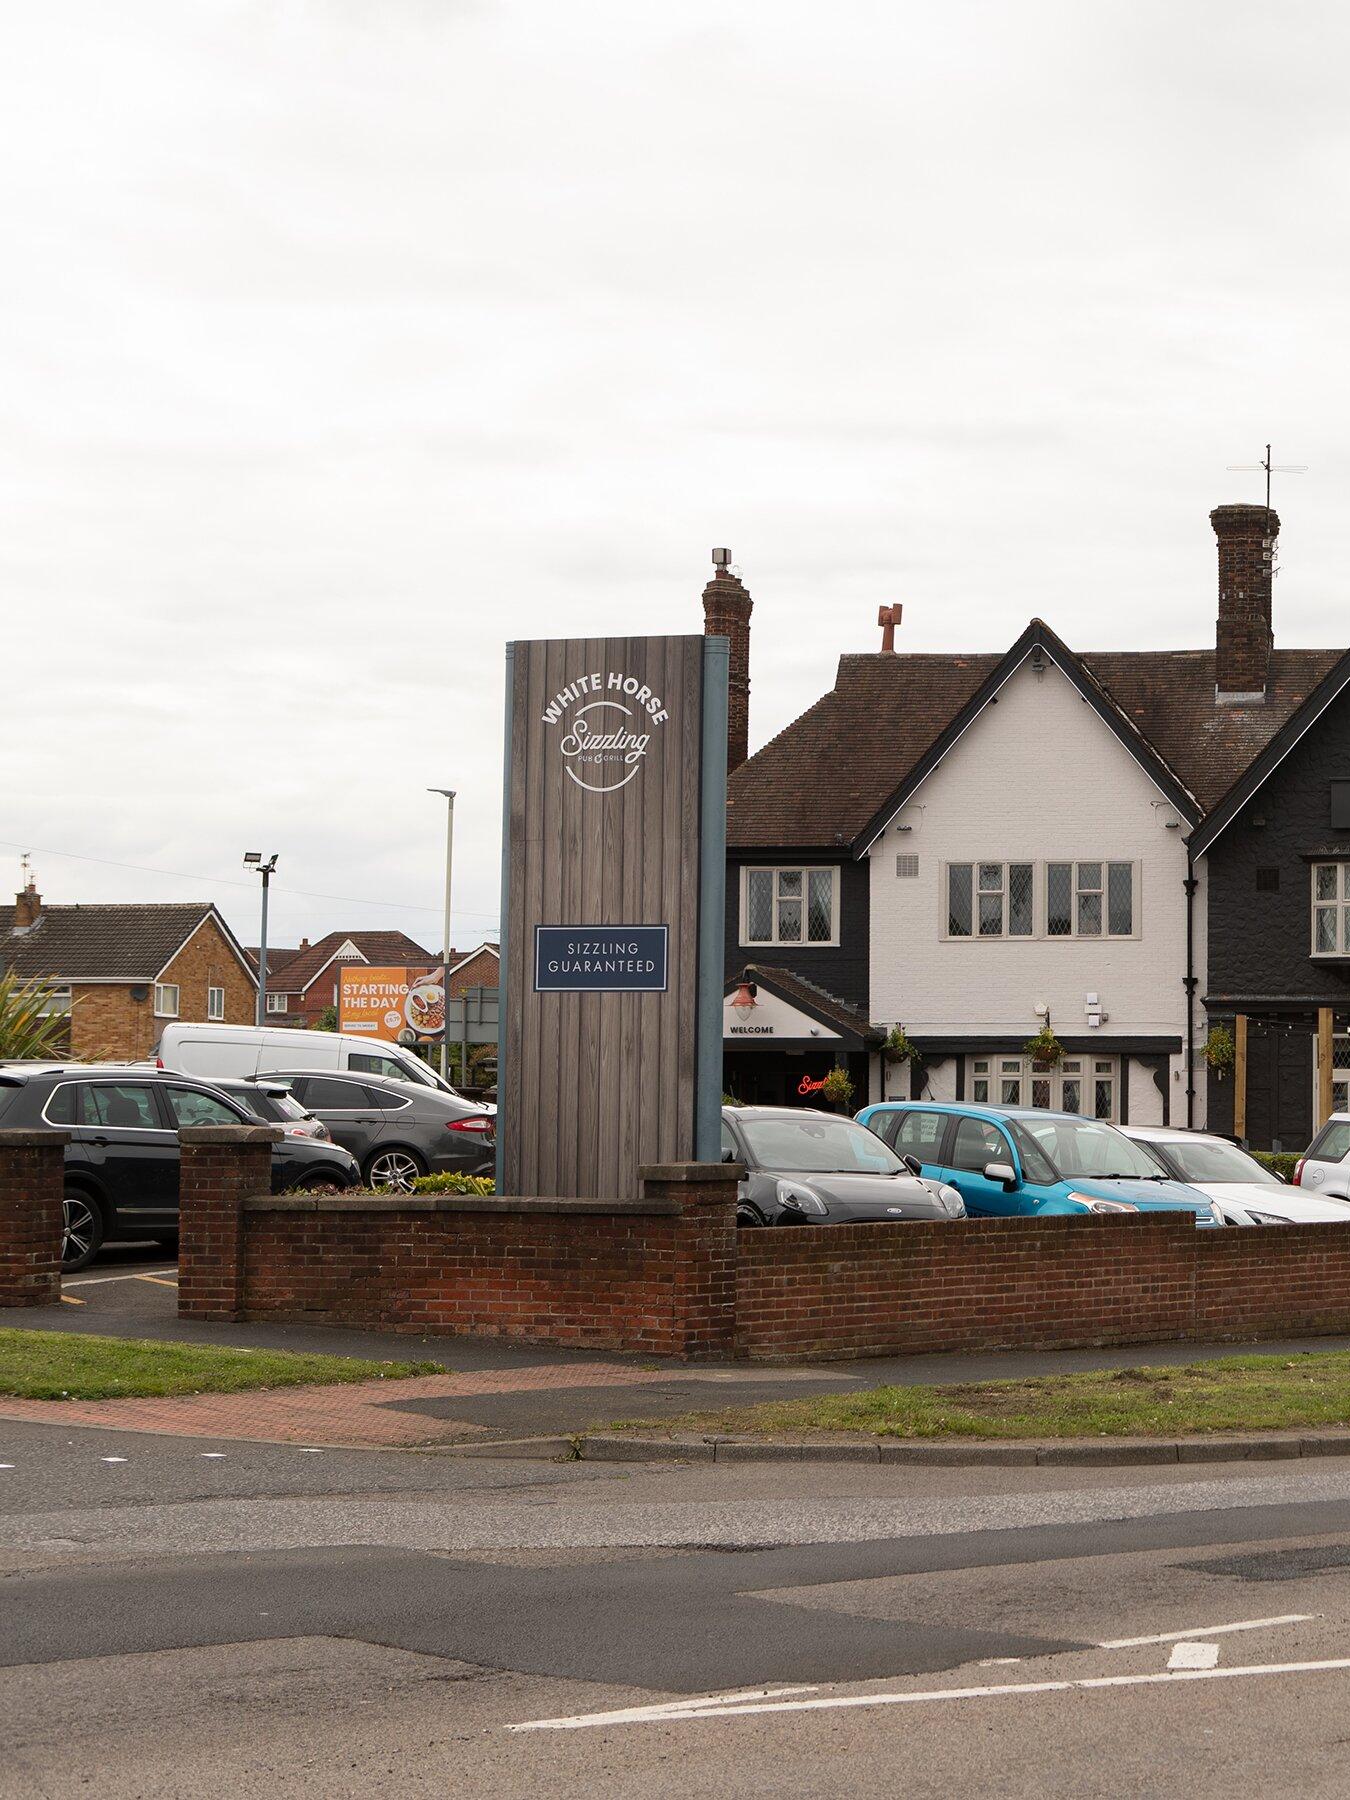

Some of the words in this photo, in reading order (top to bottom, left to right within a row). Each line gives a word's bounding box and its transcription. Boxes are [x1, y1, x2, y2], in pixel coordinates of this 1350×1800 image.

[541, 673, 602, 725] WHITE
[607, 672, 669, 726] HORSE
[560, 719, 651, 764] Sizzling
[567, 942, 639, 955] SIZZLING
[548, 960, 655, 973] GUARANTEED
[343, 983, 410, 995] STARTING
[343, 997, 368, 1008] THE
[370, 997, 399, 1008] DAY
[730, 1026, 774, 1034] WELCOME
[798, 1075, 831, 1095] Sizzl
